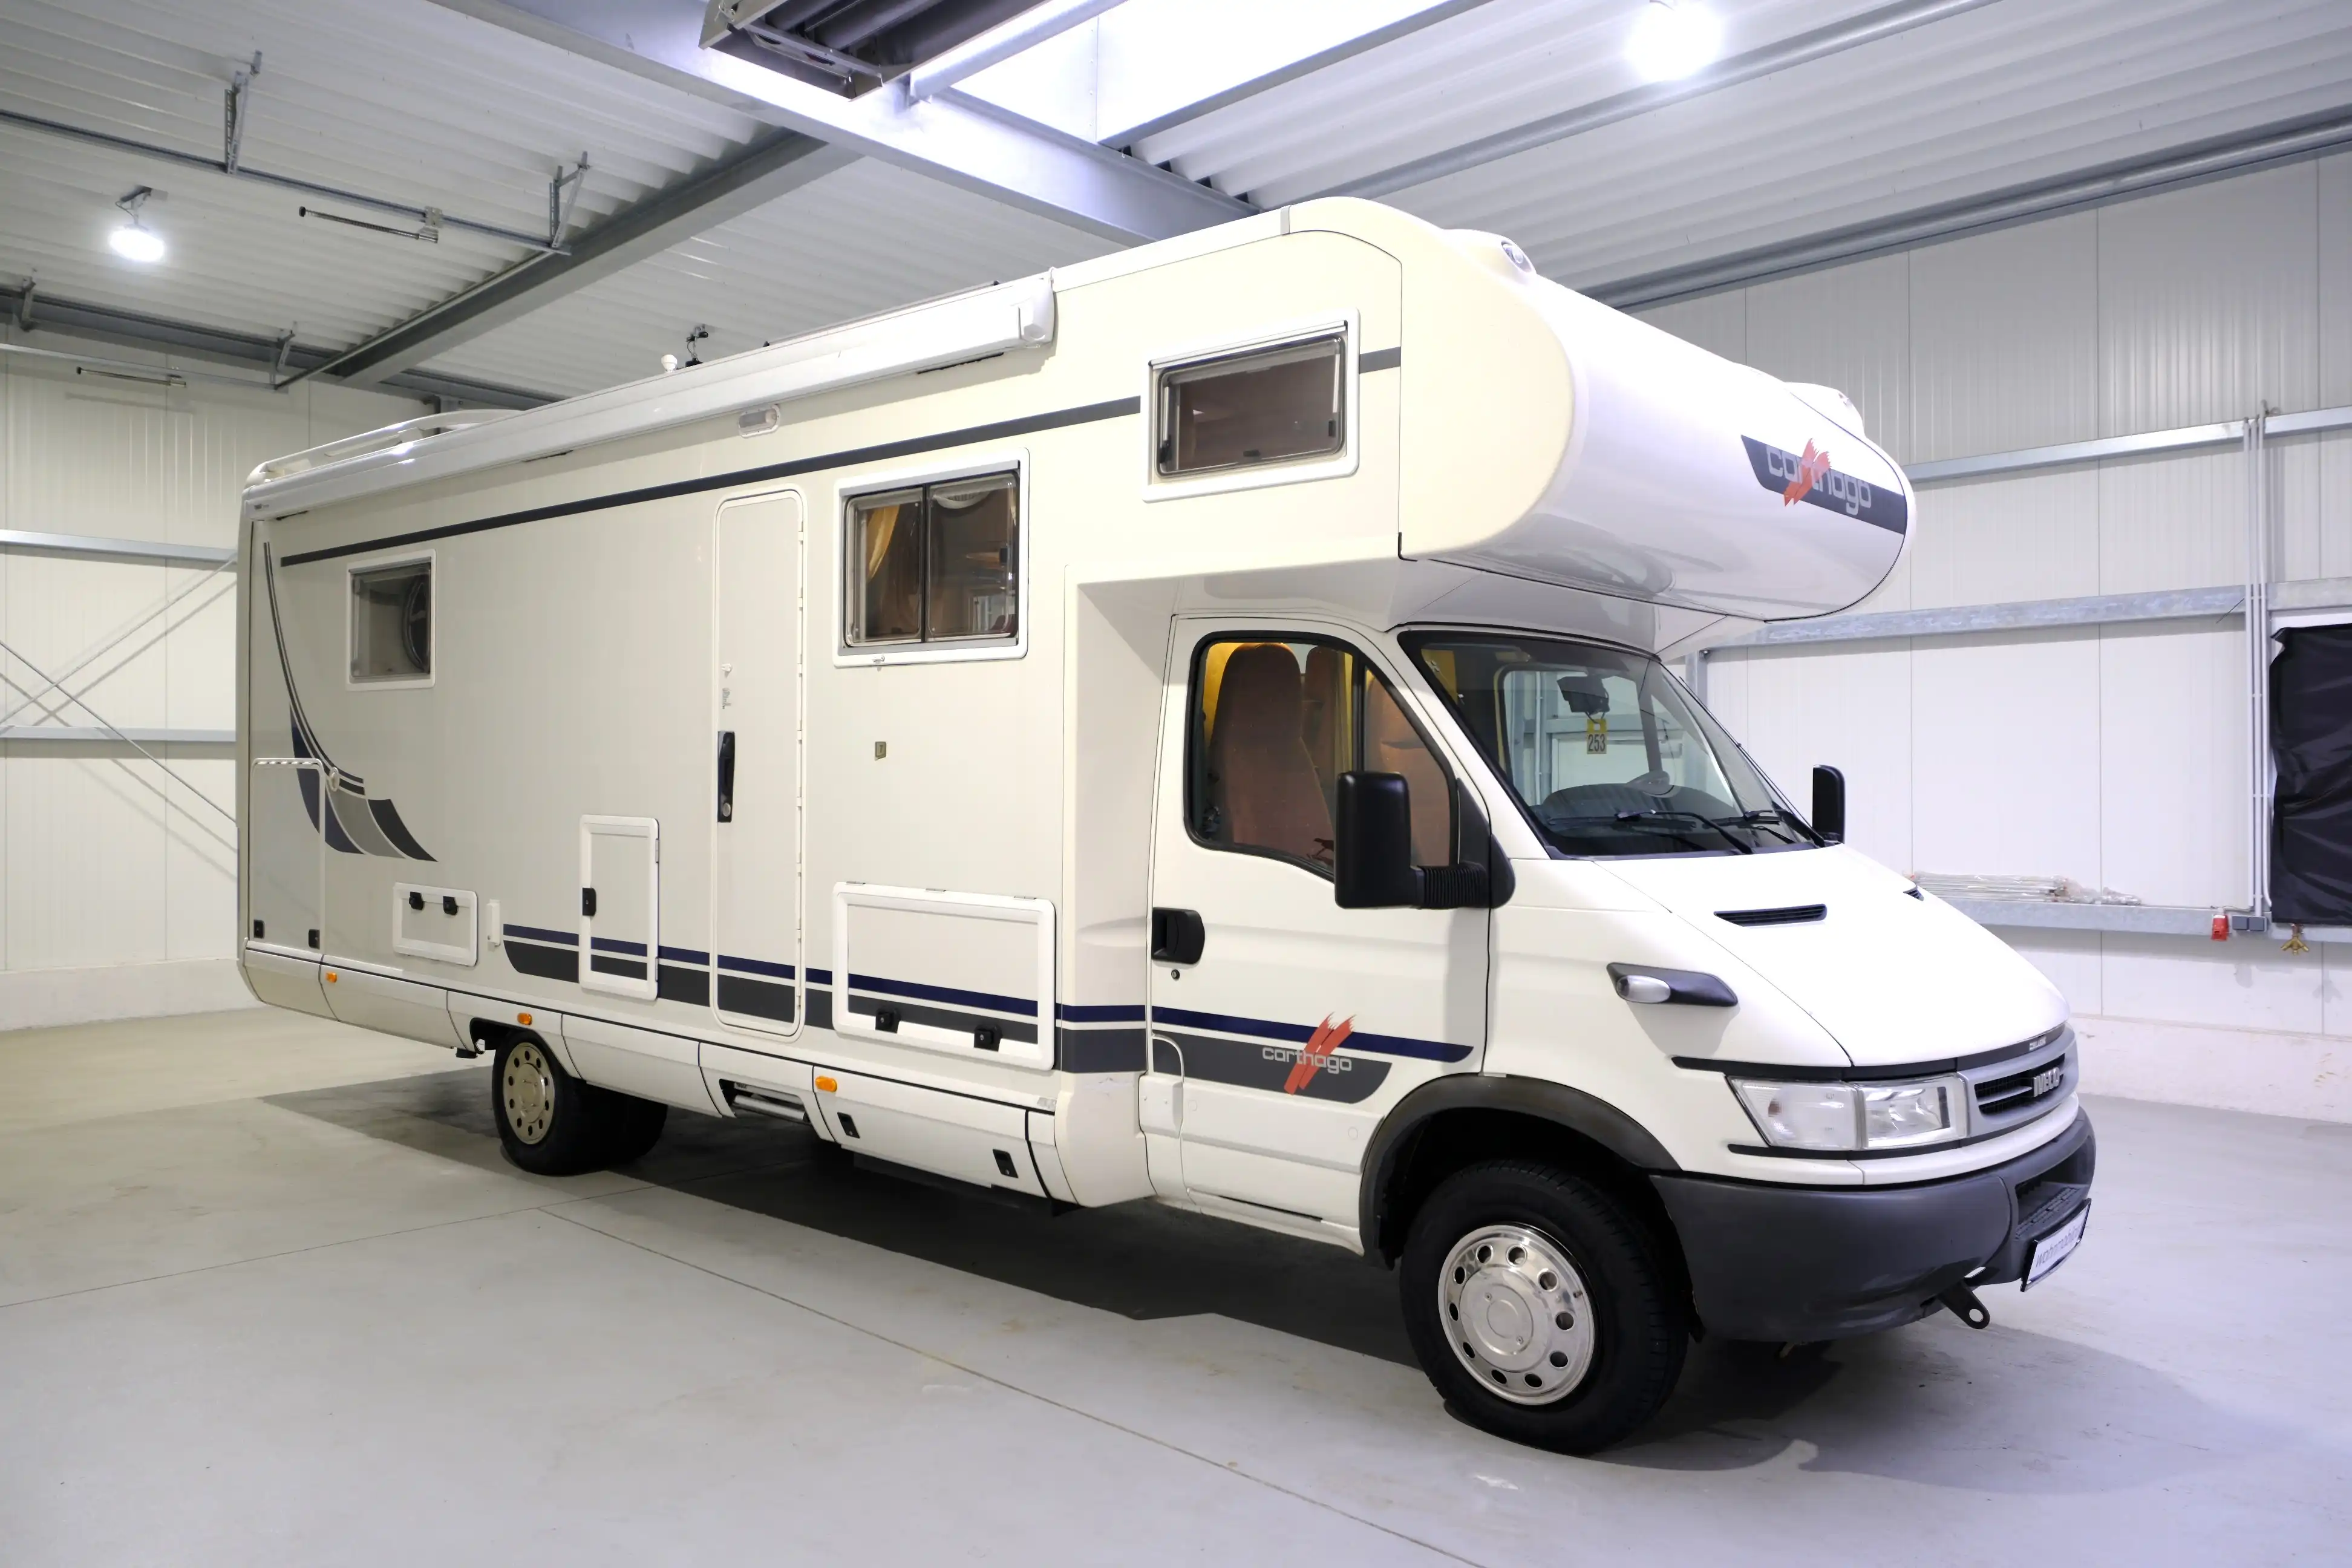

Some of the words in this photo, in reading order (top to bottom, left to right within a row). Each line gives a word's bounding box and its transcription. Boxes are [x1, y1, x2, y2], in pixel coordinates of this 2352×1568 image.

[1588, 733, 1606, 752] 253
[1262, 1047, 1352, 1074] carthago
[2033, 1067, 2060, 1097] IVECO
